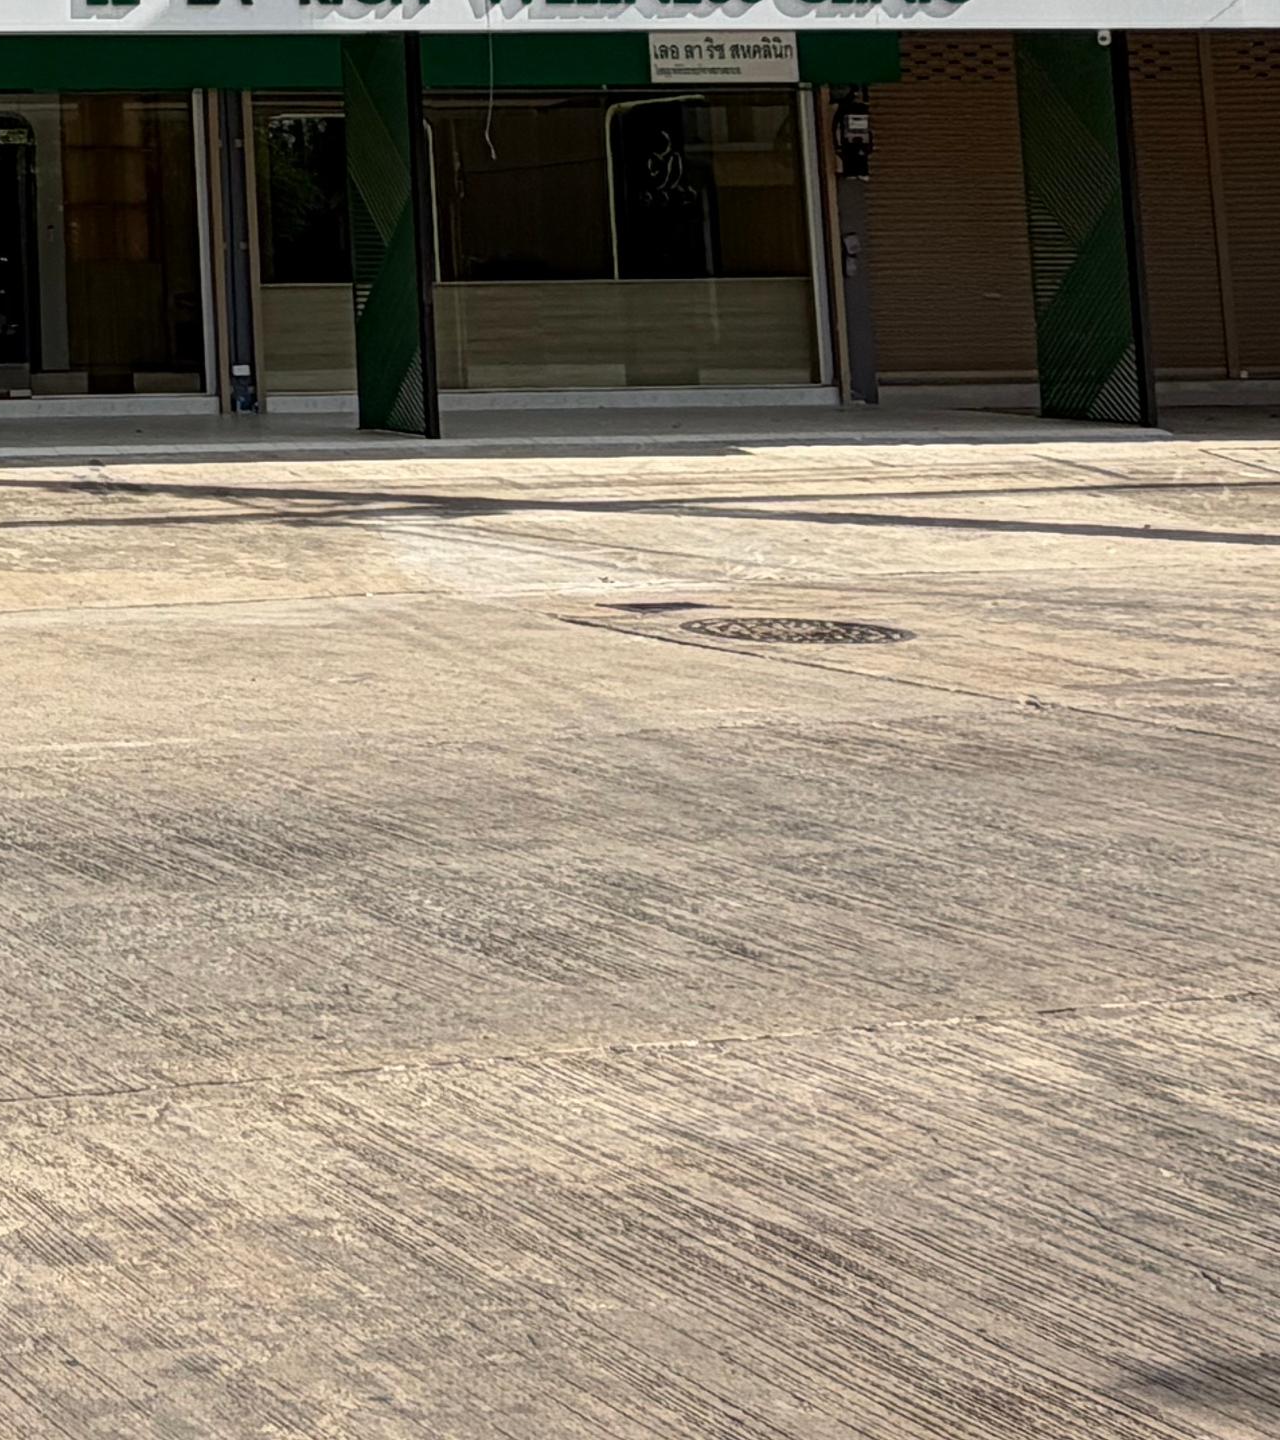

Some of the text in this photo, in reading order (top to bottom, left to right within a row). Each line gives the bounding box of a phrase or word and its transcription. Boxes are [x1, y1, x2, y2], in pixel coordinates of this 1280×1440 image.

[653, 36, 794, 60] เลอ ลา ริช สหคลินิก
